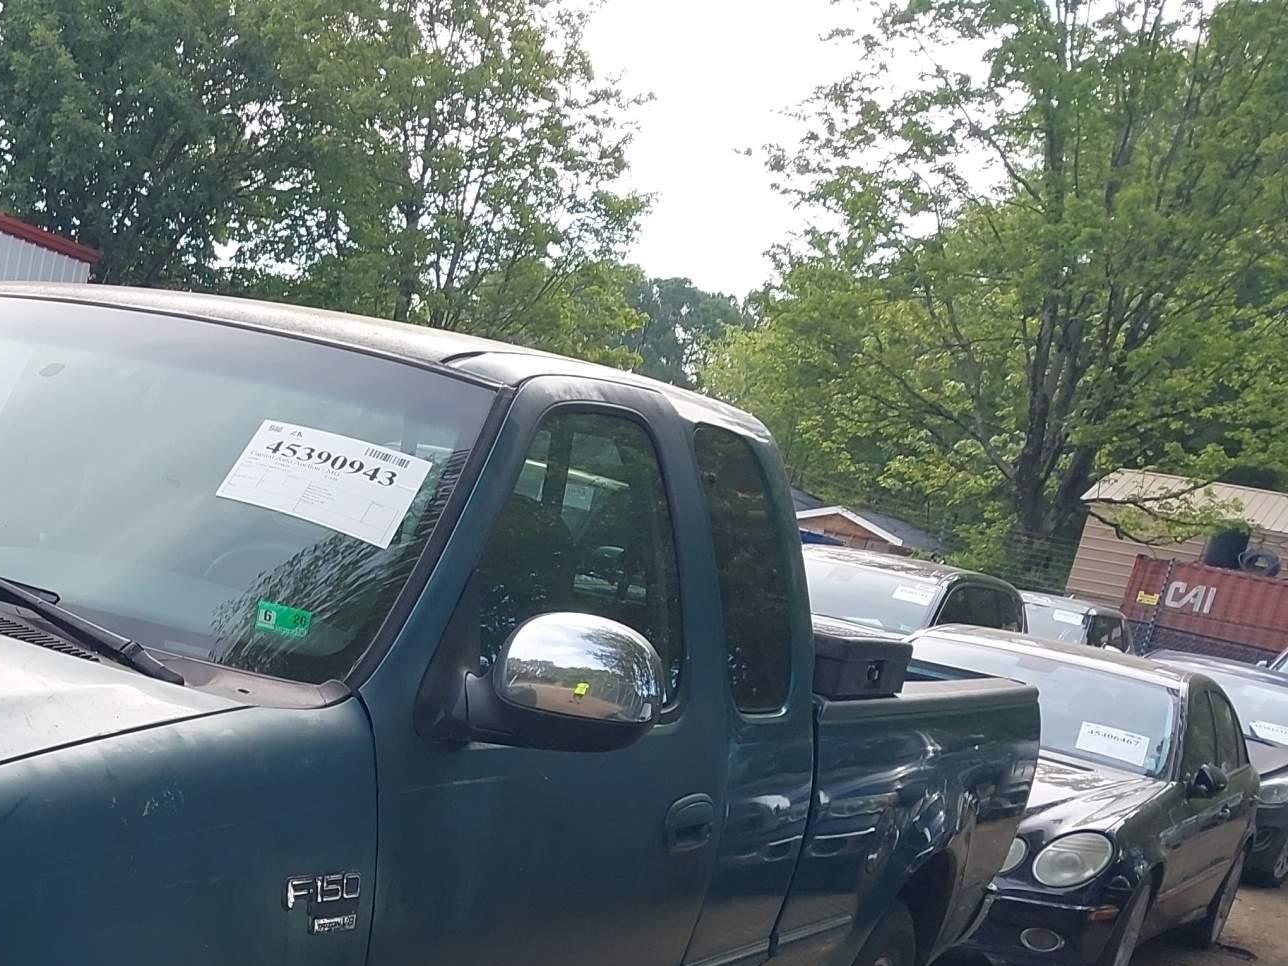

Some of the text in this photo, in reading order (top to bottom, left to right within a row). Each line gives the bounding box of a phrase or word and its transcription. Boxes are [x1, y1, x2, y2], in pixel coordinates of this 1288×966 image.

[265, 440, 398, 487] 45390943
[1165, 581, 1217, 614] CAI
[263, 609, 272, 622] 6
